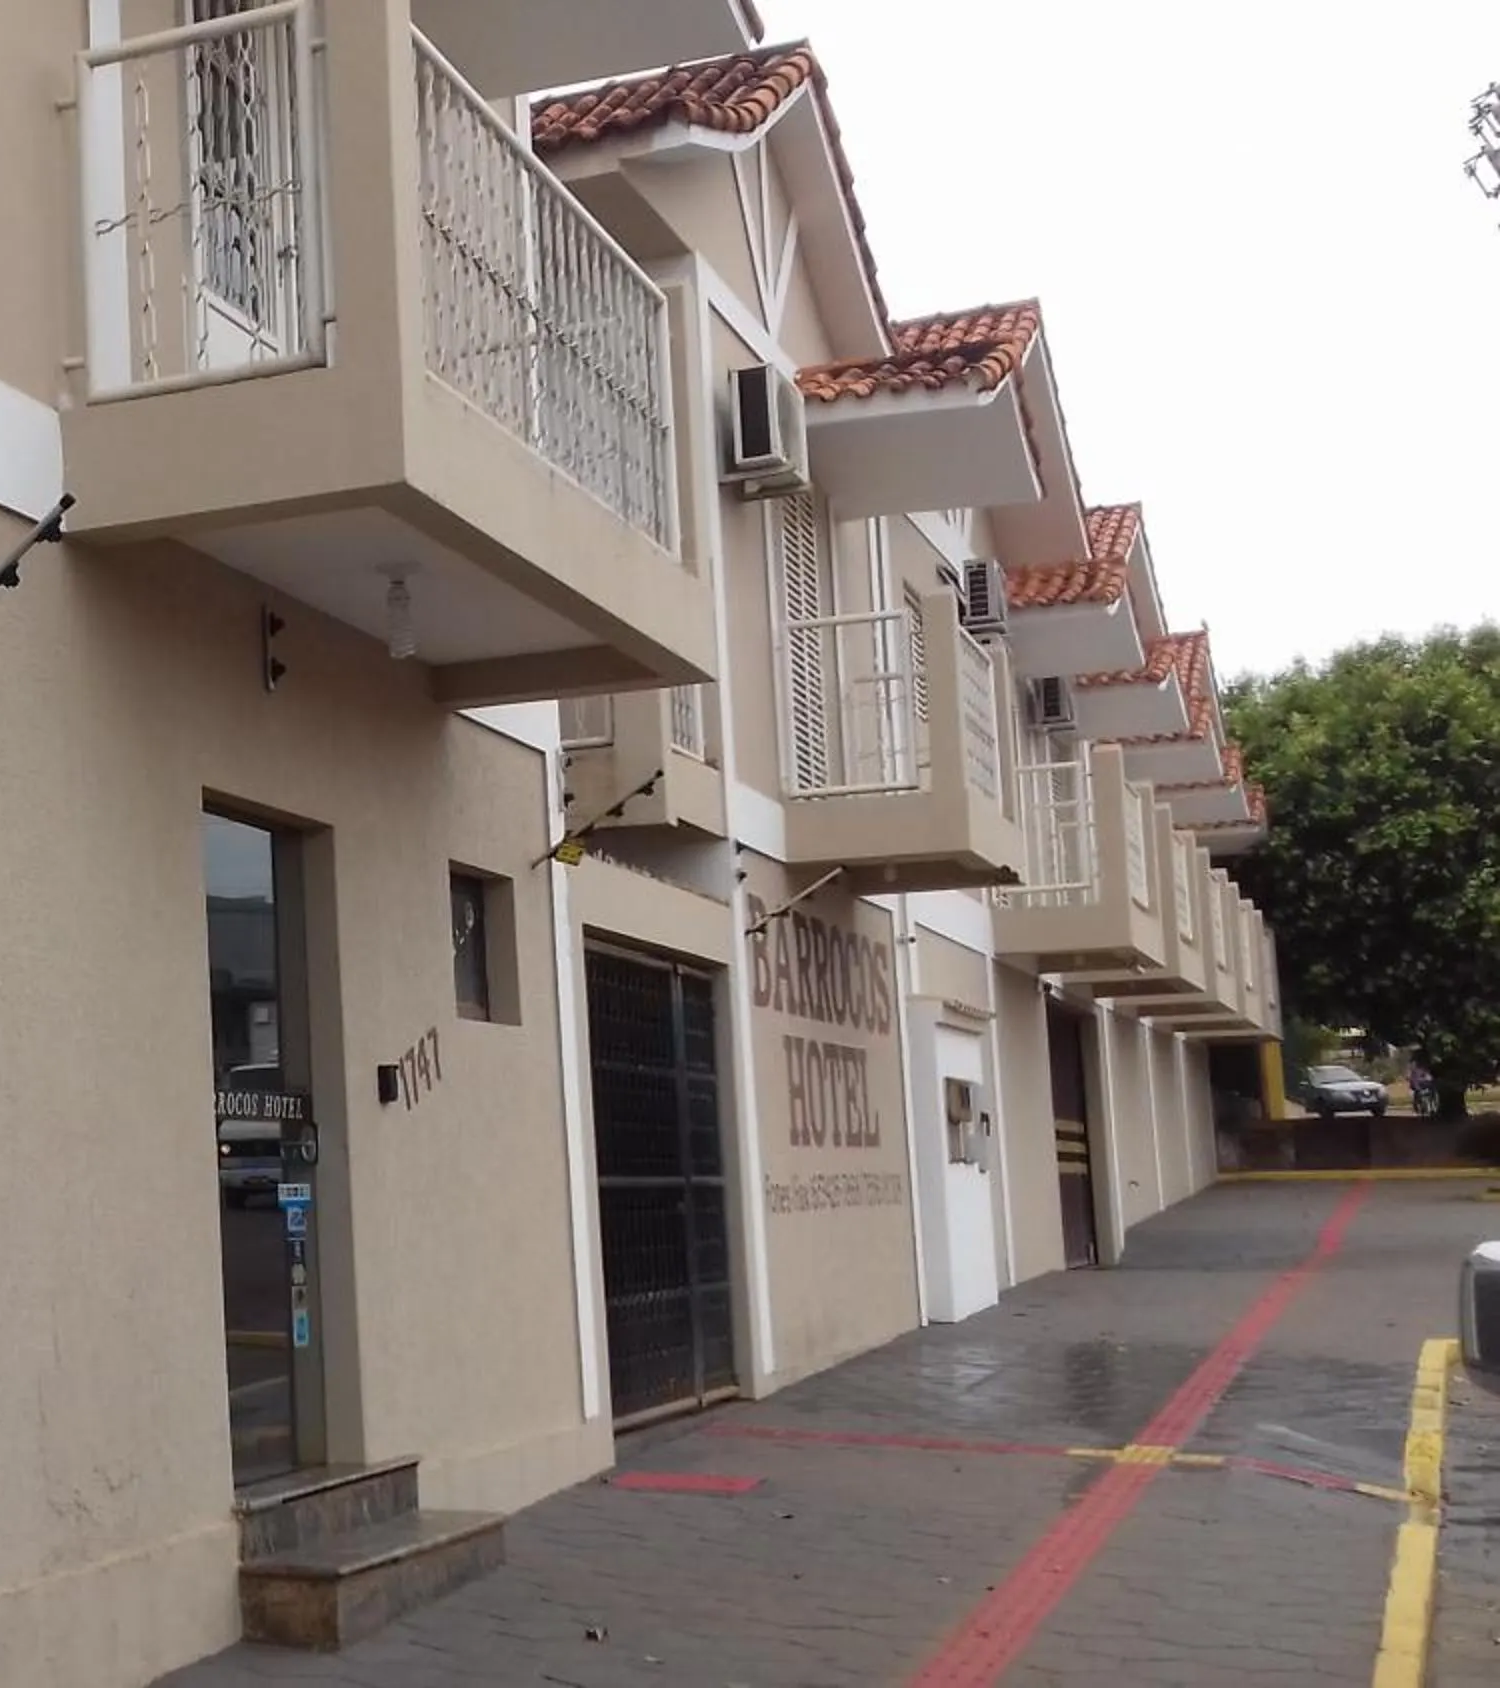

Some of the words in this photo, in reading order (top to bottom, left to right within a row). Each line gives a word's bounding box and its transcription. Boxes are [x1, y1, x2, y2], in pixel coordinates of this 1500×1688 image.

[749, 894, 890, 1036] BARROCOS
[214, 1091, 259, 1117] ROCOS
[263, 1095, 303, 1119] HOTEL
[399, 1026, 441, 1111] 1747
[783, 1035, 880, 1147] HOTEL
